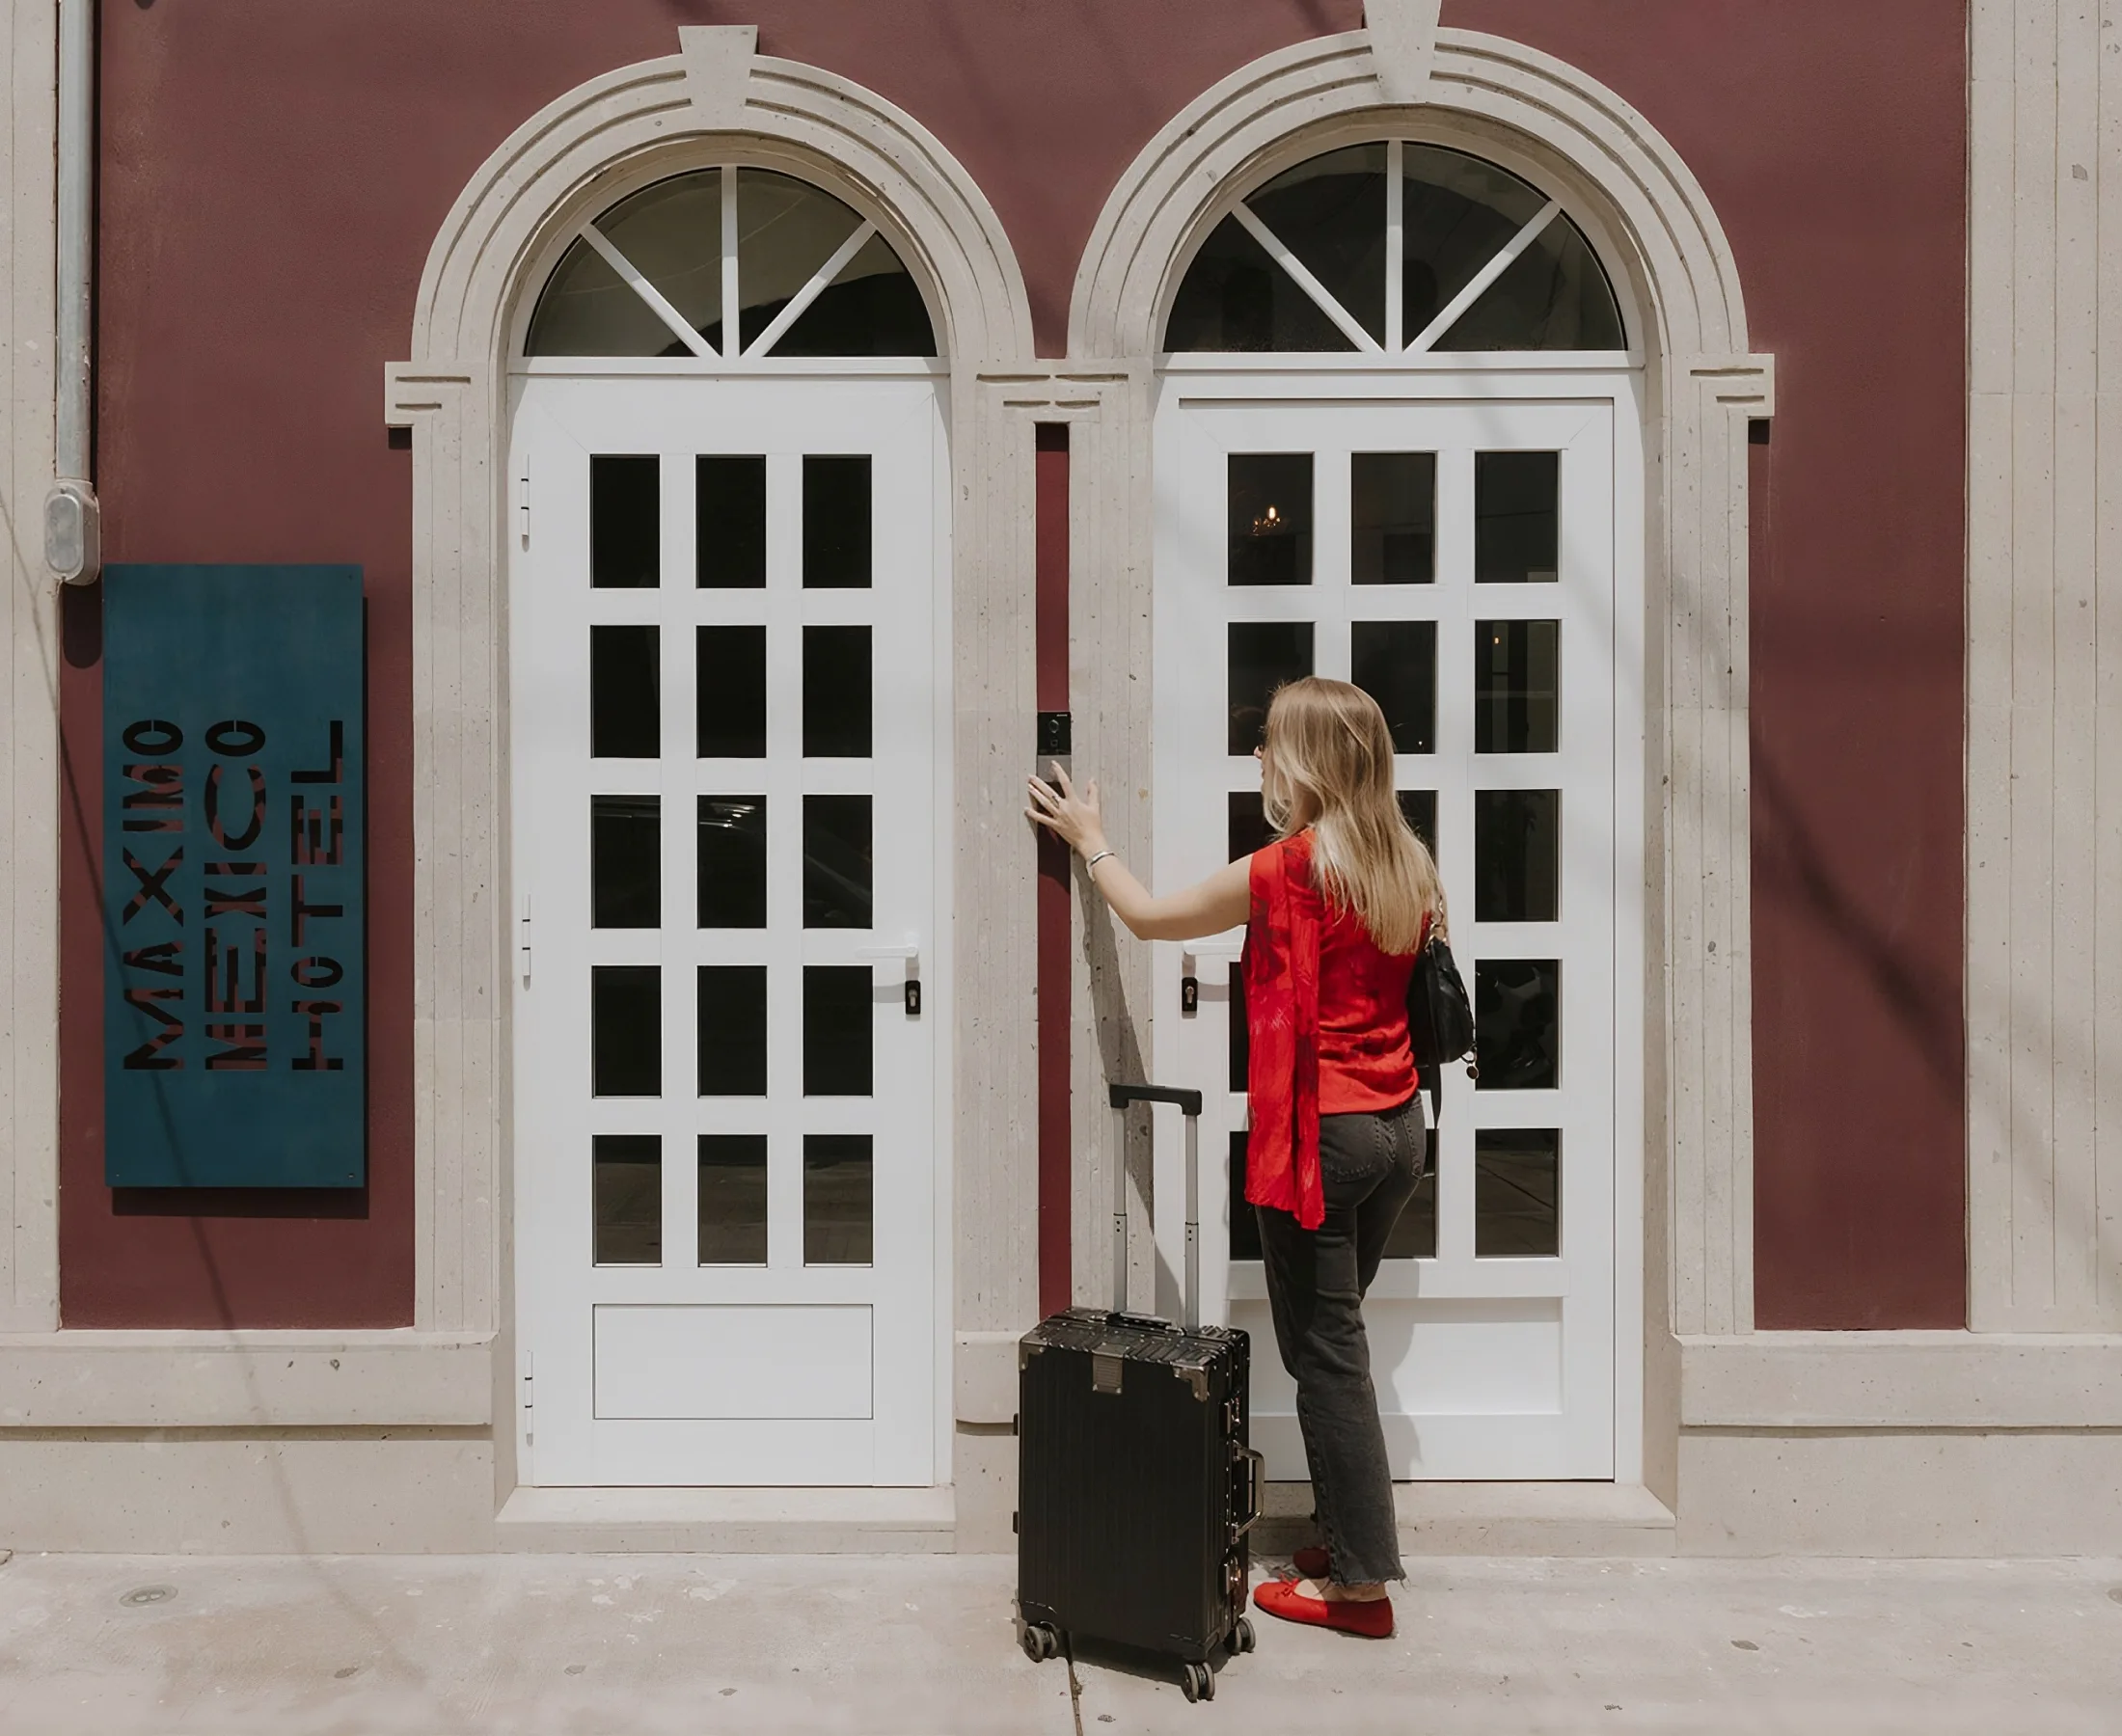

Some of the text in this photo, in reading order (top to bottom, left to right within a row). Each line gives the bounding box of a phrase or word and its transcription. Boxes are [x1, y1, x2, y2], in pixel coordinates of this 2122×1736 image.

[122, 719, 184, 1070] MAXIMO
[204, 719, 267, 1070] MEXICO
[290, 720, 343, 1070] HOTEL
